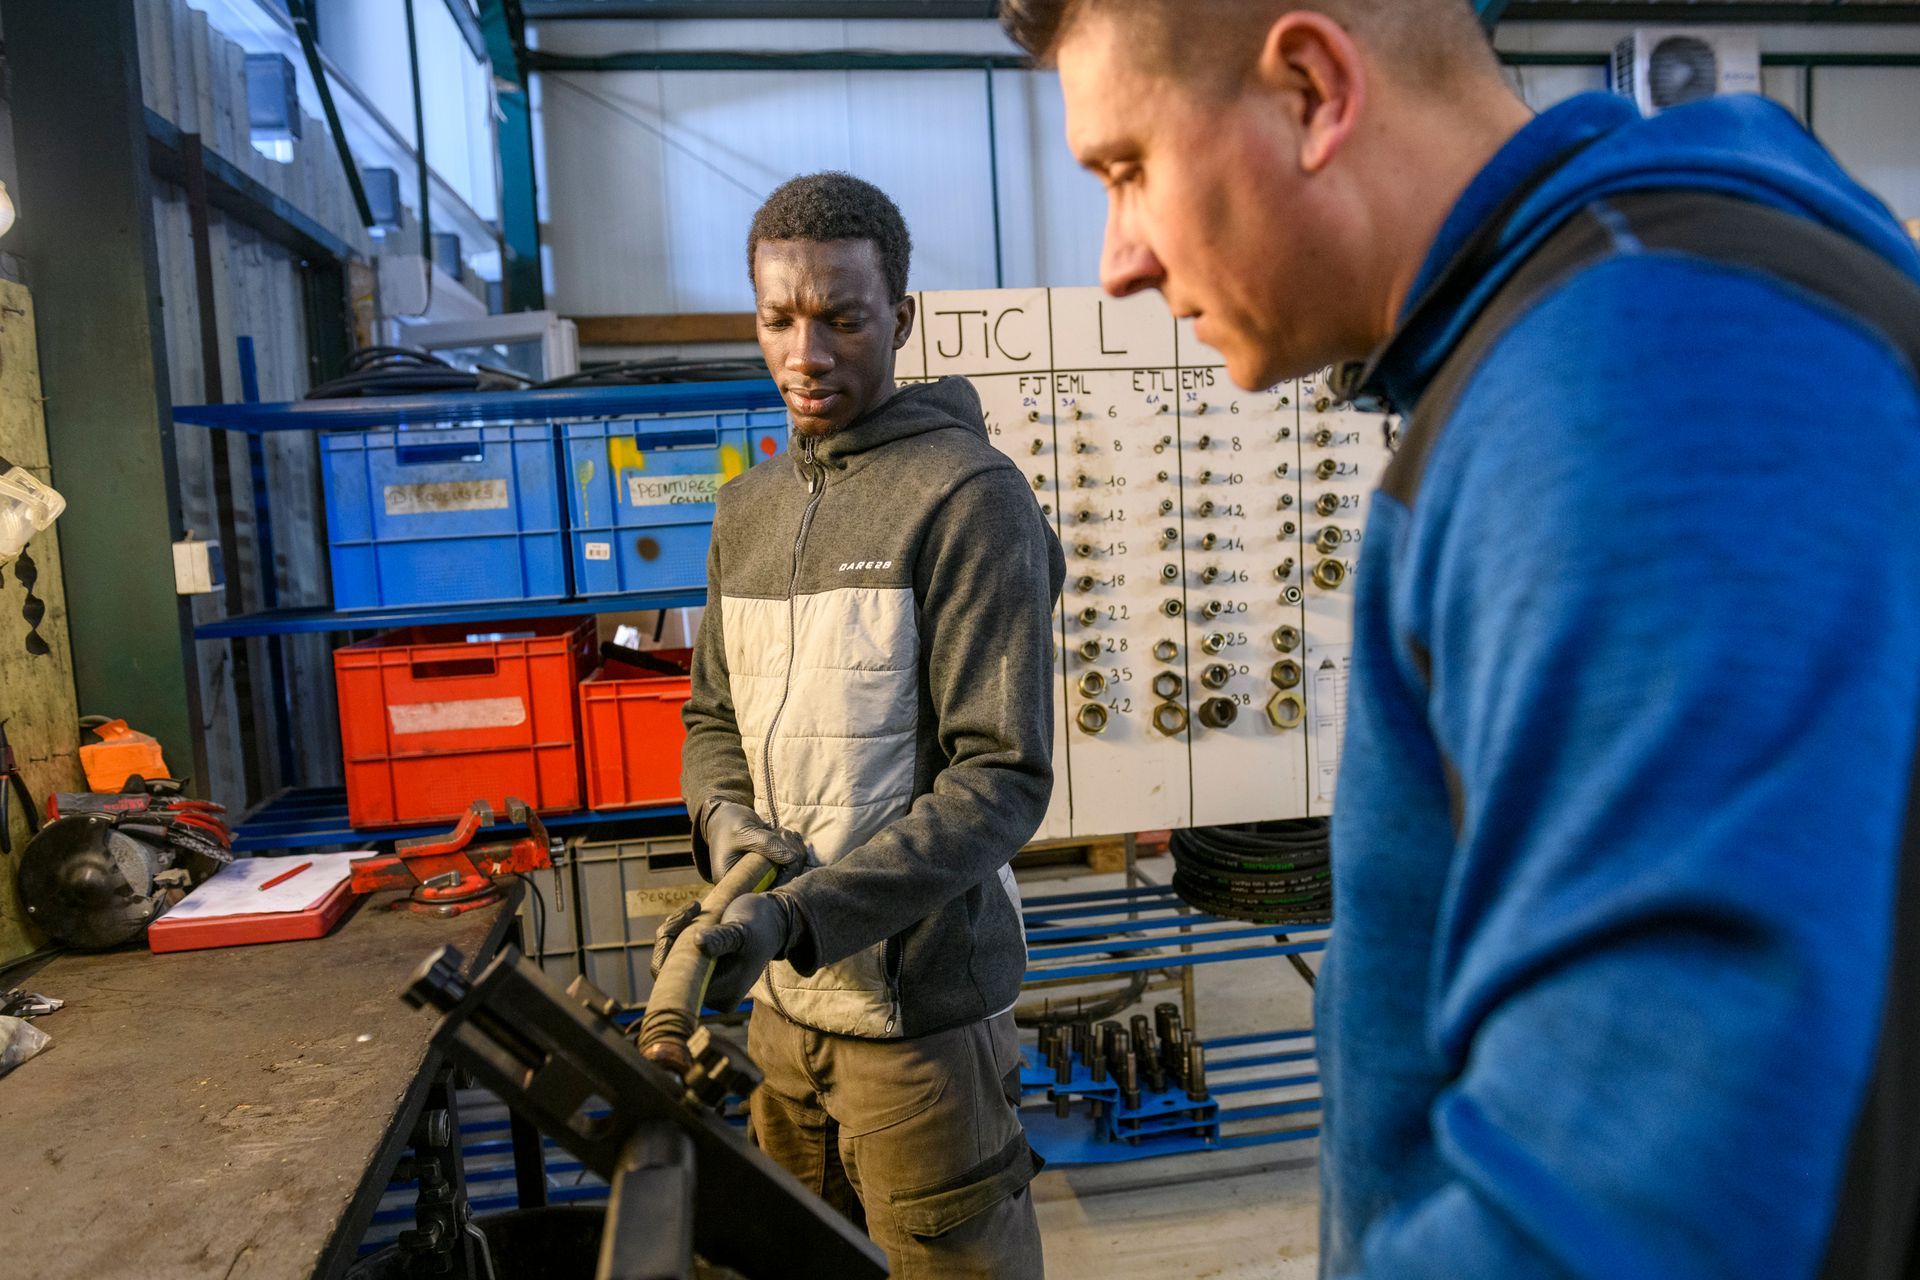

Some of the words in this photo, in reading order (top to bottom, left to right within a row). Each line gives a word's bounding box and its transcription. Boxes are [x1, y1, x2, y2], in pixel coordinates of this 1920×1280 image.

[1098, 300, 1128, 355] L
[1019, 376, 1047, 395] FJ
[1056, 374, 1091, 394] EML
[1133, 370, 1173, 392] ETL
[1182, 367, 1215, 389] EMS
[1107, 405, 1118, 418] 6
[1229, 400, 1240, 415] 6
[1113, 439, 1123, 451] 8
[1231, 436, 1243, 452] 8
[1338, 431, 1360, 445] 17
[1335, 462, 1359, 476] 21
[1104, 474, 1127, 488] 10
[1221, 473, 1244, 486] 10
[637, 480, 718, 498] PEINTURES
[1340, 493, 1360, 509] 27
[1101, 509, 1127, 523] 12
[1222, 502, 1245, 518] 12
[1342, 527, 1362, 543] 33
[1102, 541, 1128, 556] 15
[1220, 537, 1245, 552] 14
[838, 561, 892, 572] DARE2B
[1101, 574, 1126, 588] 18
[1223, 569, 1249, 584] 16
[1108, 604, 1131, 621] 22
[1223, 599, 1248, 614] 20
[1106, 637, 1129, 653] 28
[1226, 631, 1248, 647] 25
[1110, 667, 1133, 684] 35
[1226, 663, 1250, 678] 30
[1108, 697, 1133, 715] 42
[1231, 693, 1251, 706] 38
